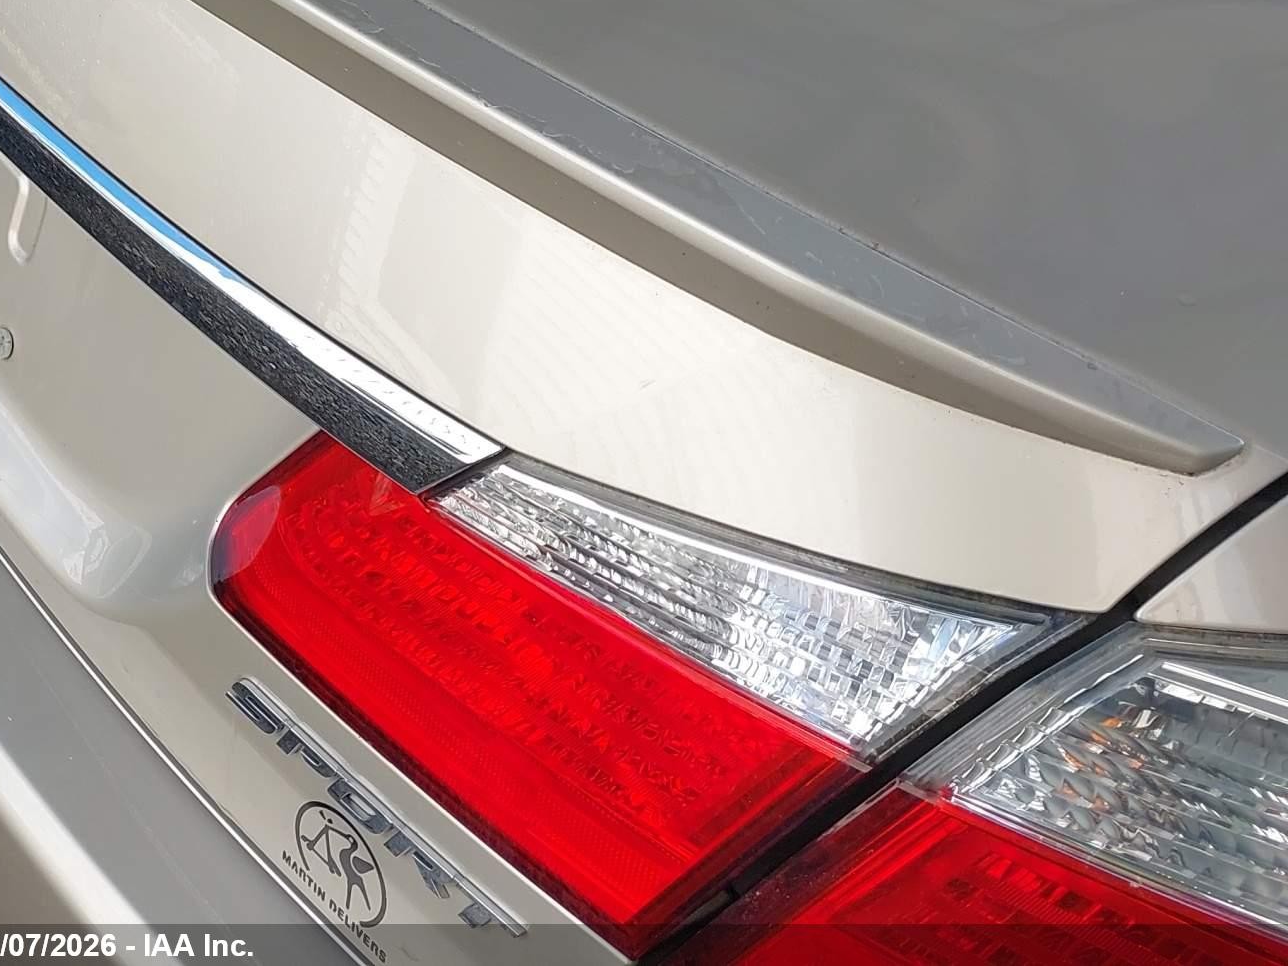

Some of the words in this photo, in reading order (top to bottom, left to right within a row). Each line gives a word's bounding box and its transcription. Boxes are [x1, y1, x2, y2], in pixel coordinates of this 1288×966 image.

[220, 675, 530, 938] SPORT
[281, 849, 327, 902] MARTIN
[328, 898, 387, 964] DELIVERS
